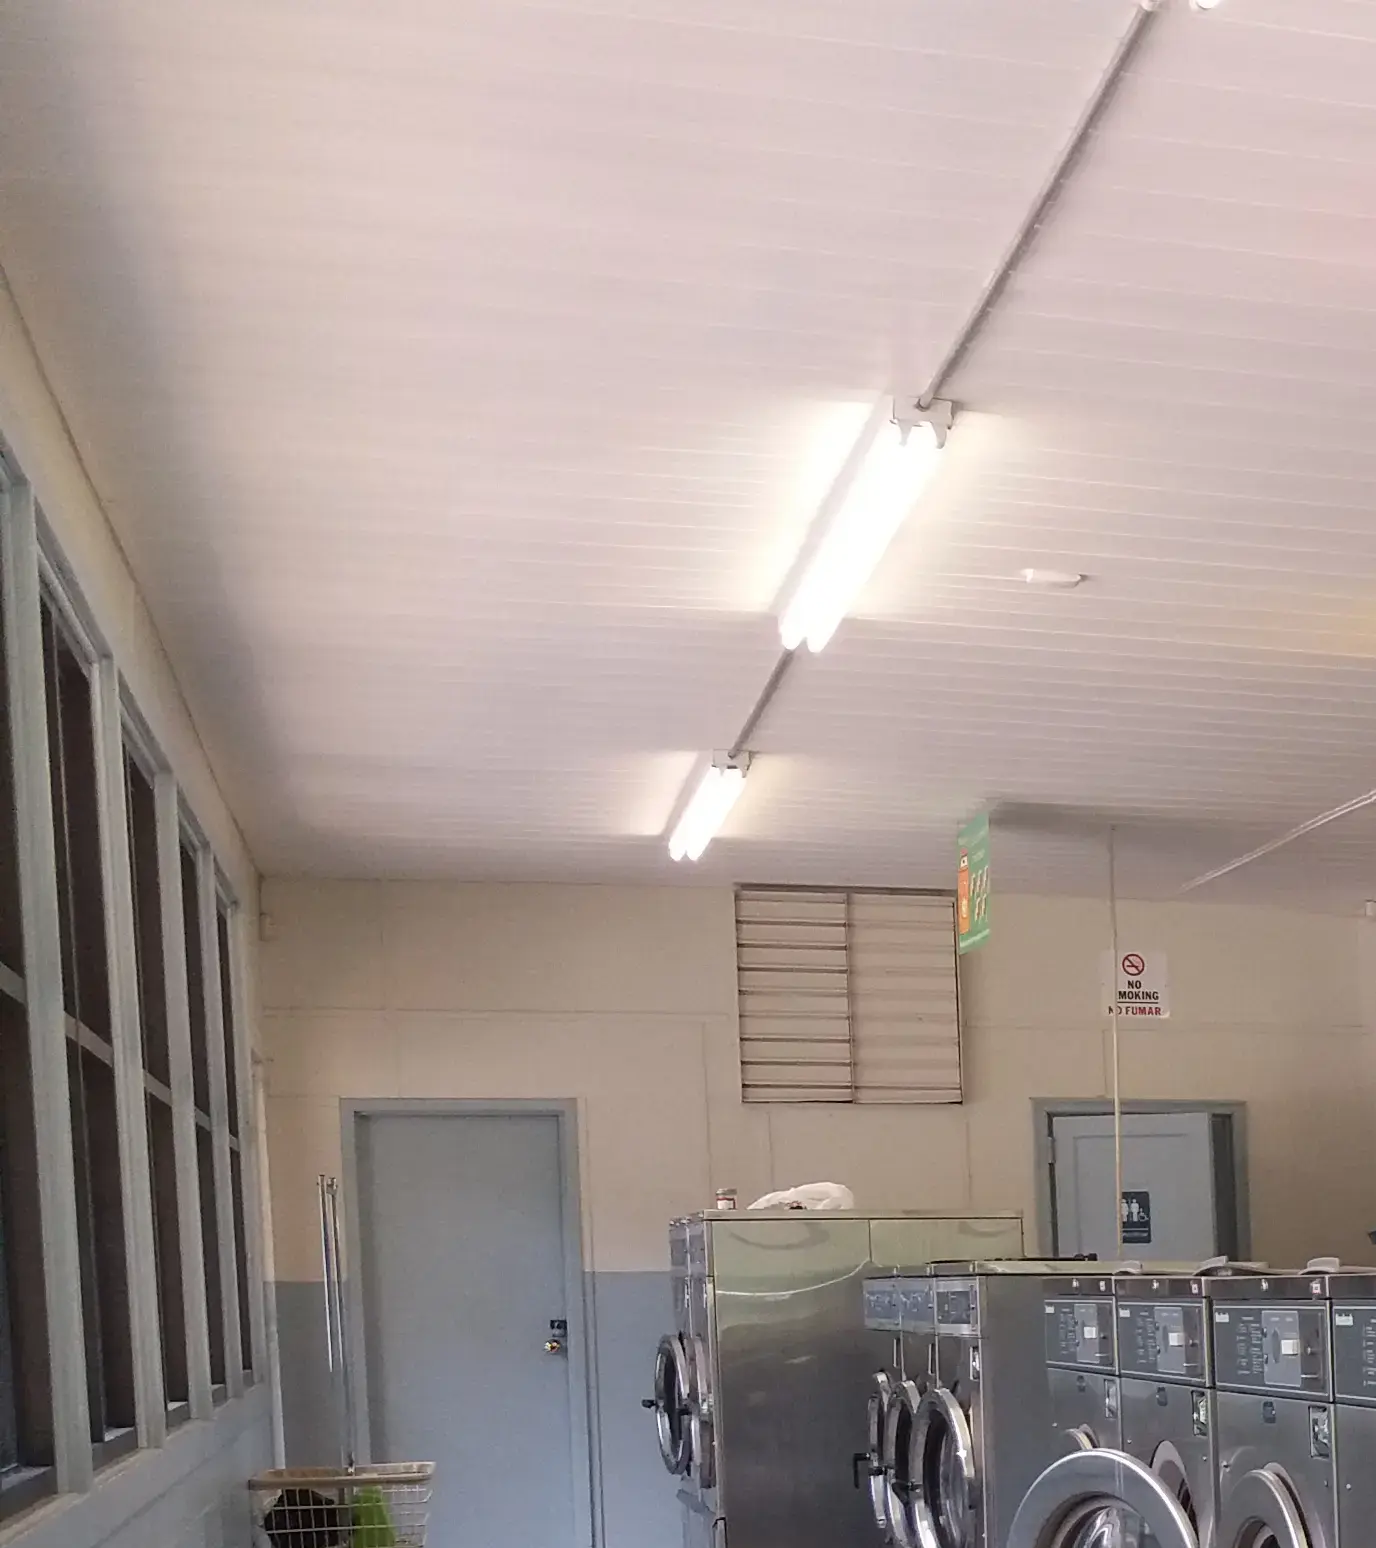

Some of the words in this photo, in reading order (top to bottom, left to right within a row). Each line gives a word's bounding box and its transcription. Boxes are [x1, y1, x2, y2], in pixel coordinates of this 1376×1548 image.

[1127, 980, 1142, 989] NO
[1118, 990, 1159, 1000] MOKING
[1125, 1006, 1161, 1016] FUMAR
